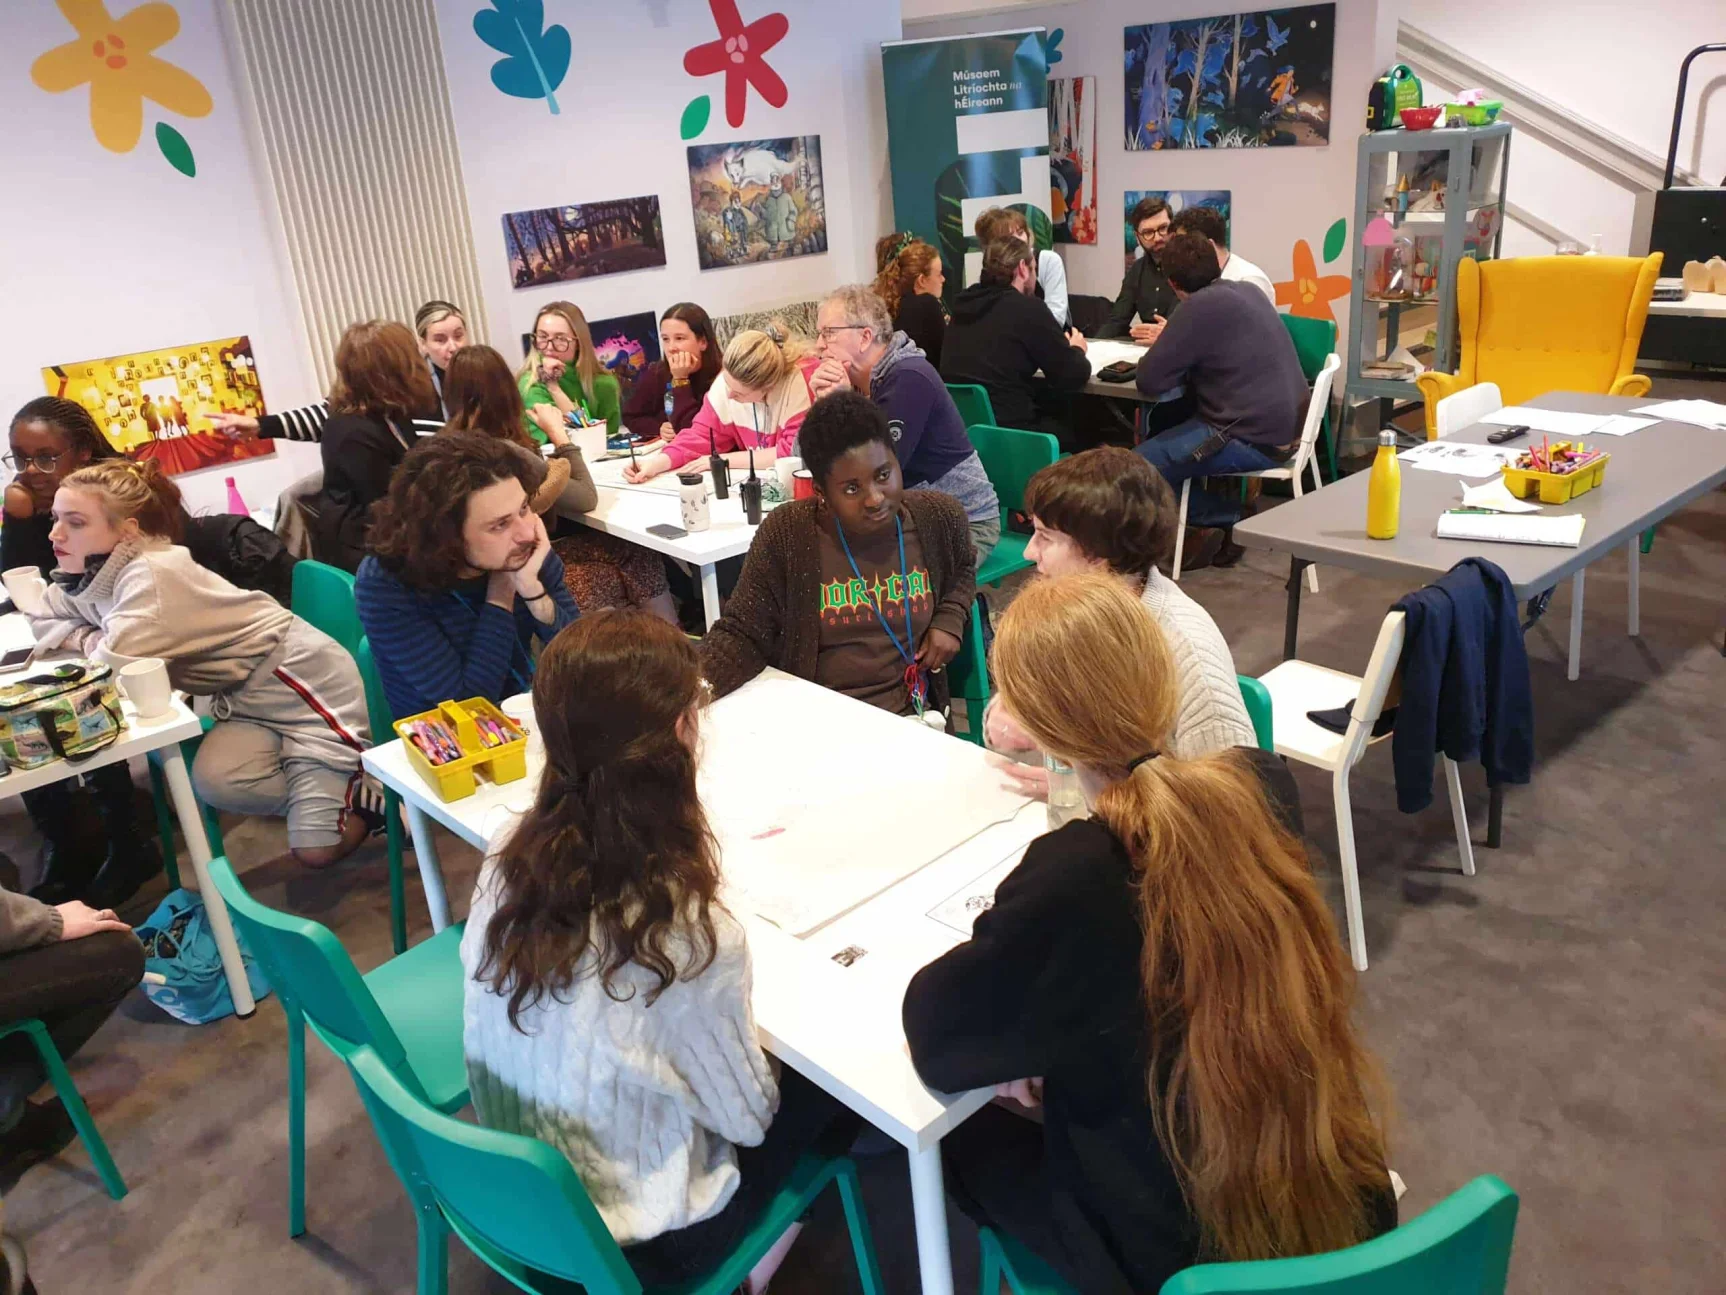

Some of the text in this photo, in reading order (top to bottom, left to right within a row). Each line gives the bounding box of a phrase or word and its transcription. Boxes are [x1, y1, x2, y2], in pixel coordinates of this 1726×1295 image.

[953, 70, 1000, 81] Músaem
[953, 82, 1007, 95] Litríochta
[954, 96, 1003, 108] hÉireann
